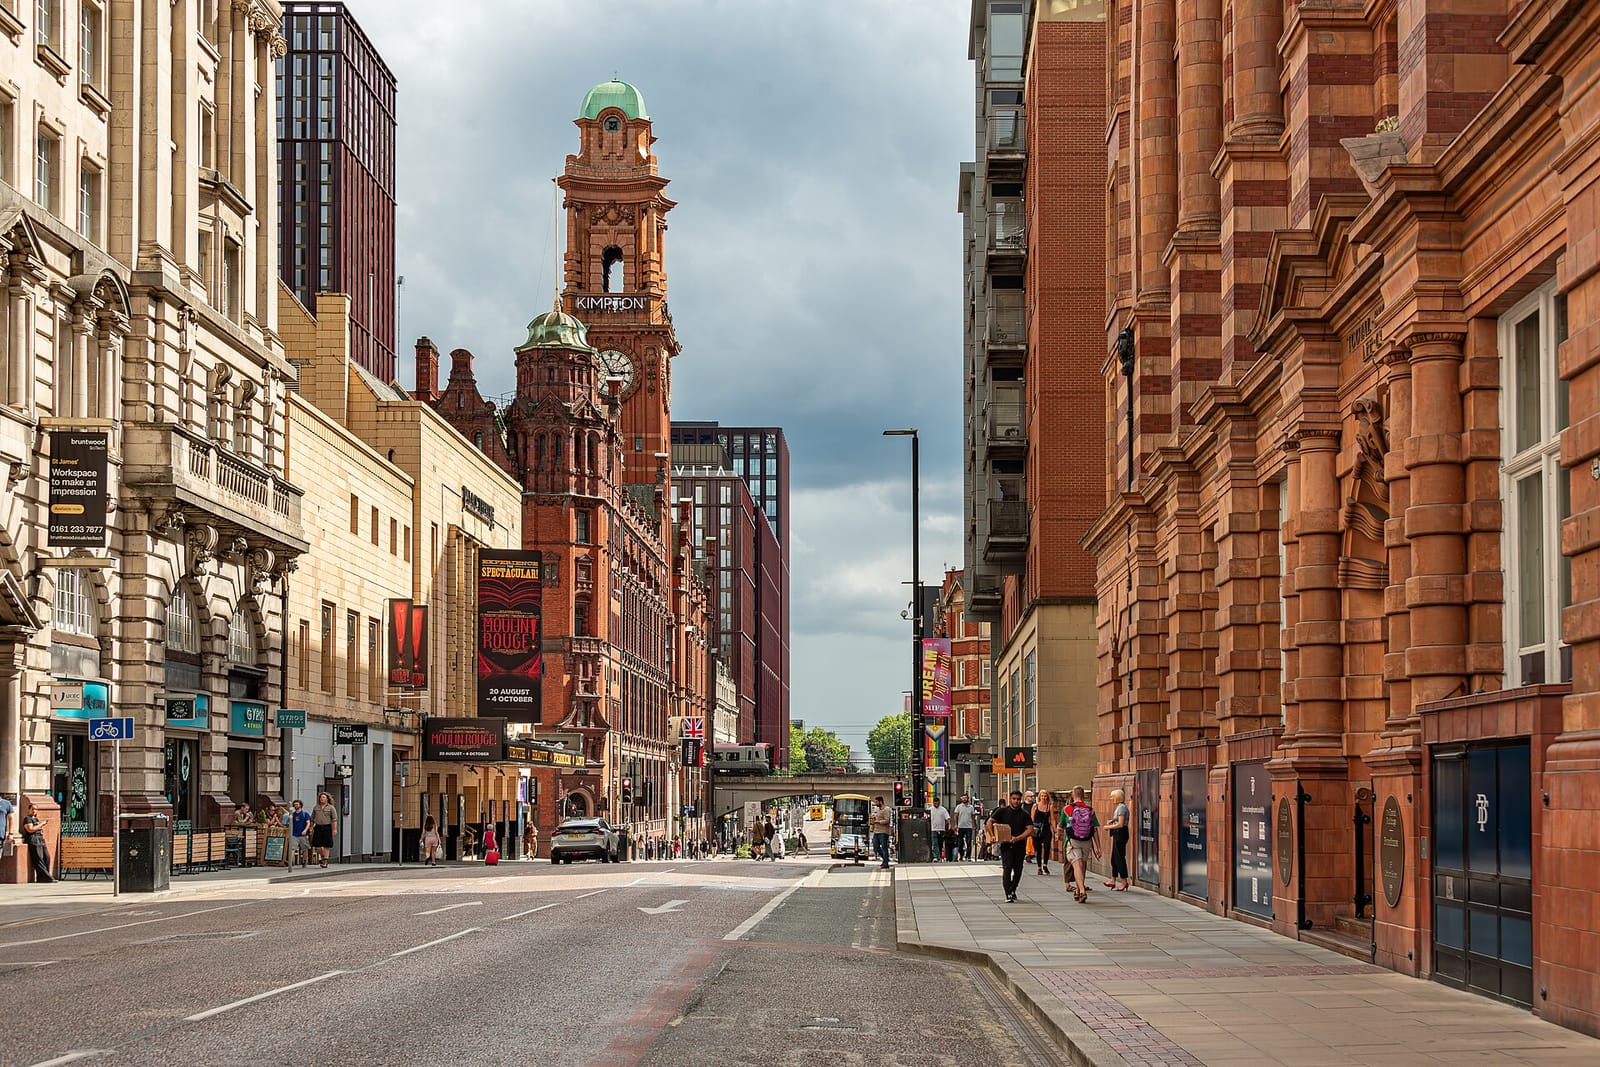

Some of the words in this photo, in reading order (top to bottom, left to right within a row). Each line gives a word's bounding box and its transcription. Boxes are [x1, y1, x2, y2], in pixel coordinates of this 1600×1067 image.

[576, 297, 644, 310] KIMPTON
[70, 438, 106, 446] bruntwood
[51, 468, 98, 478] Workspace
[51, 478, 60, 486] to
[61, 478, 84, 486] make
[86, 479, 97, 487] an
[51, 486, 97, 496] impression
[50, 525, 68, 533] 0161
[70, 525, 84, 533] 233
[85, 526, 104, 534] 7877
[481, 566, 539, 579] SPECTACULAR!
[483, 616, 529, 633] MOULIN
[922, 649, 938, 701] DREAM
[339, 730, 353, 739] Stage
[431, 732, 463, 745] MOULIN
